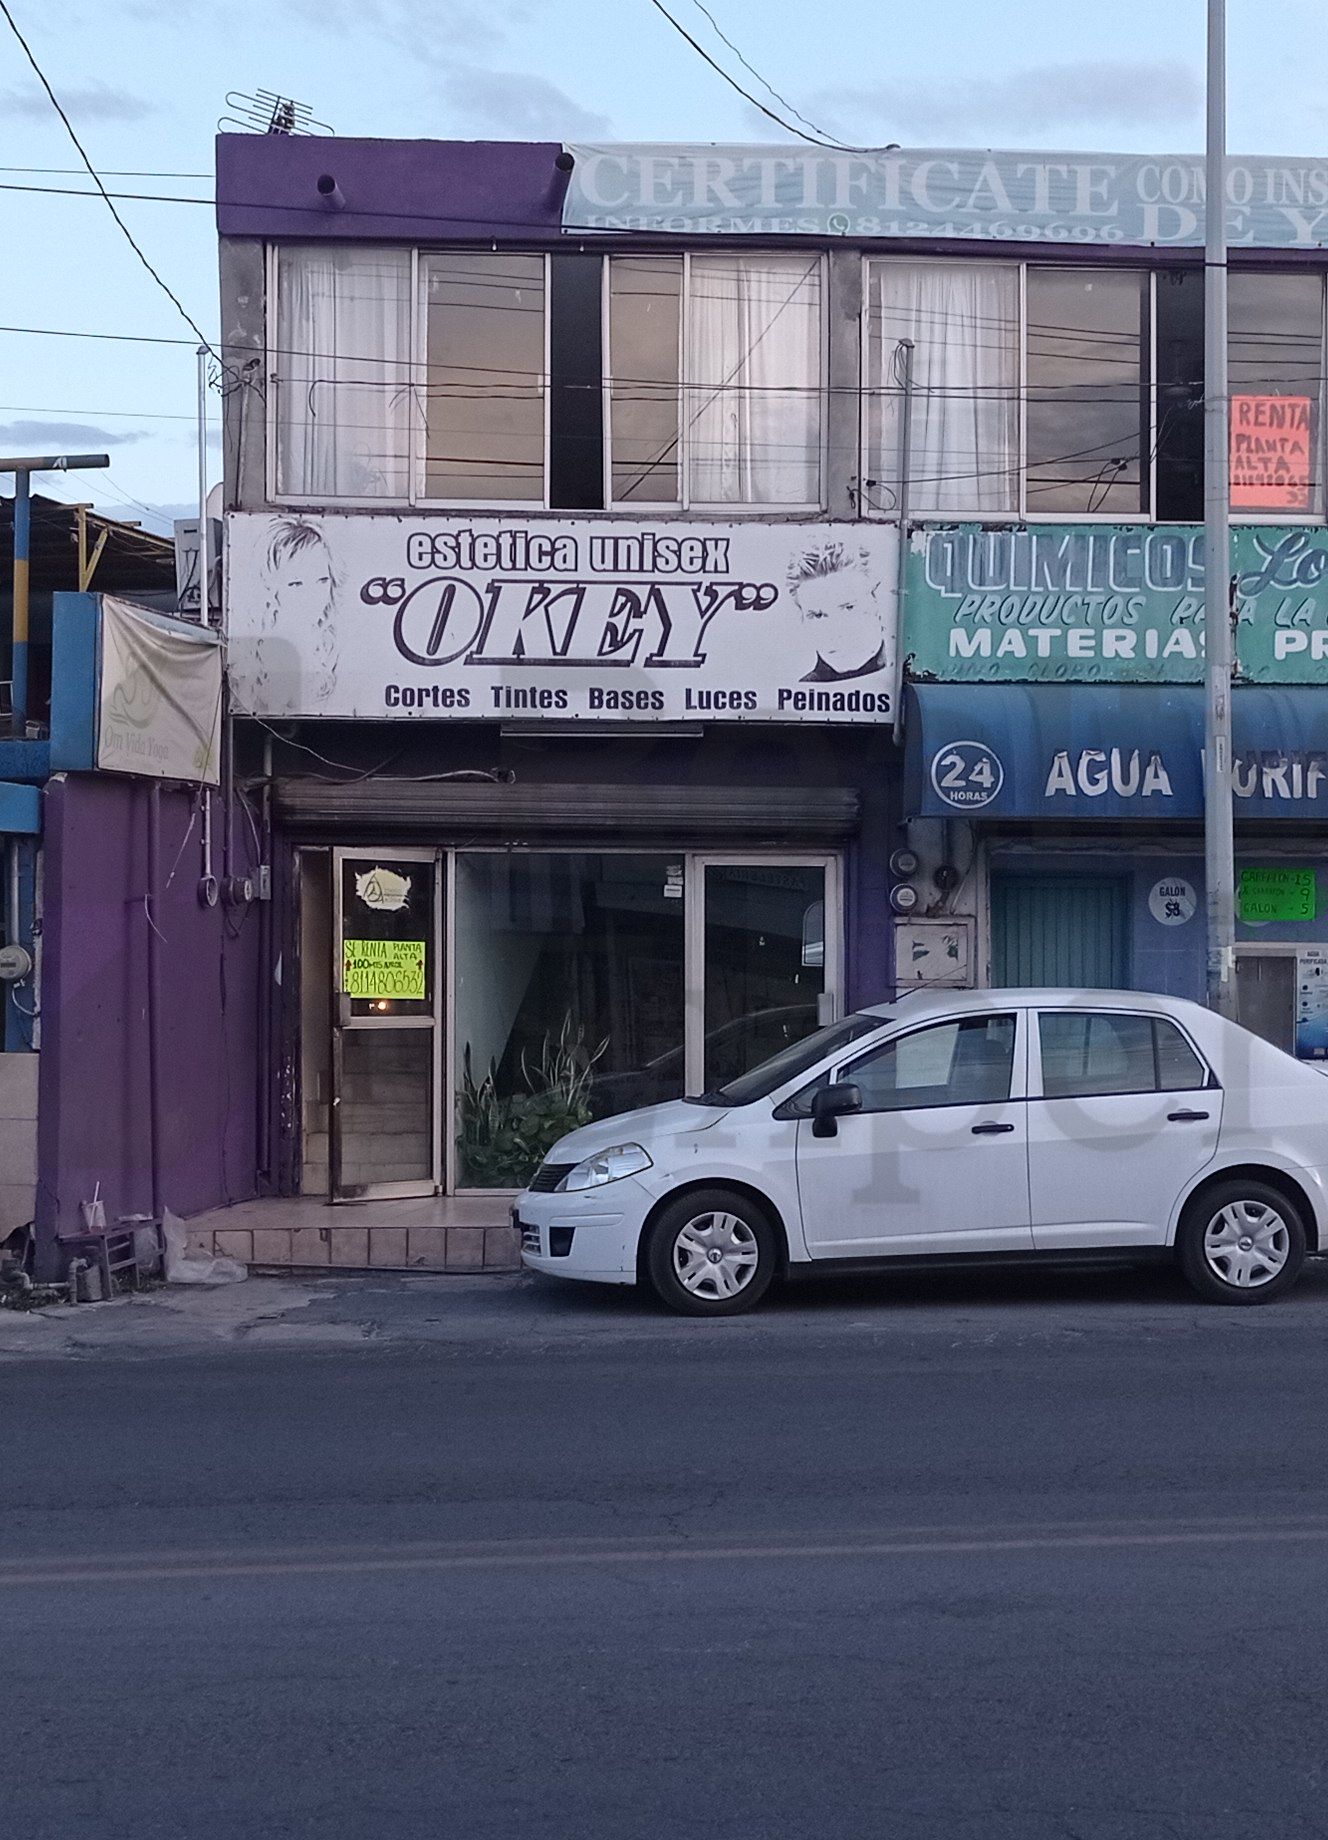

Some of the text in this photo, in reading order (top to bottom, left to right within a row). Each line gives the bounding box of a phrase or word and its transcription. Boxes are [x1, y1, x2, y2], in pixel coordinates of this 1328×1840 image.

[579, 151, 1118, 216] CERTIFICATE
[586, 214, 1124, 242] INFORMES 8124469696
[1238, 401, 1310, 431] RENTA
[1235, 433, 1305, 455] PLANTA
[1234, 455, 1291, 474] ALTA
[407, 529, 730, 574] estetica unisex
[953, 595, 1146, 626] PRODUCTOS
[1169, 596, 1258, 627] PAA
[1274, 597, 1313, 628] LA
[948, 627, 1206, 660] MATERIA
[384, 683, 892, 714] Cortes Tintes Bases Luces Peinados
[938, 752, 996, 789] 24
[1044, 747, 1173, 798] AGUA
[948, 789, 988, 803] HORAS
